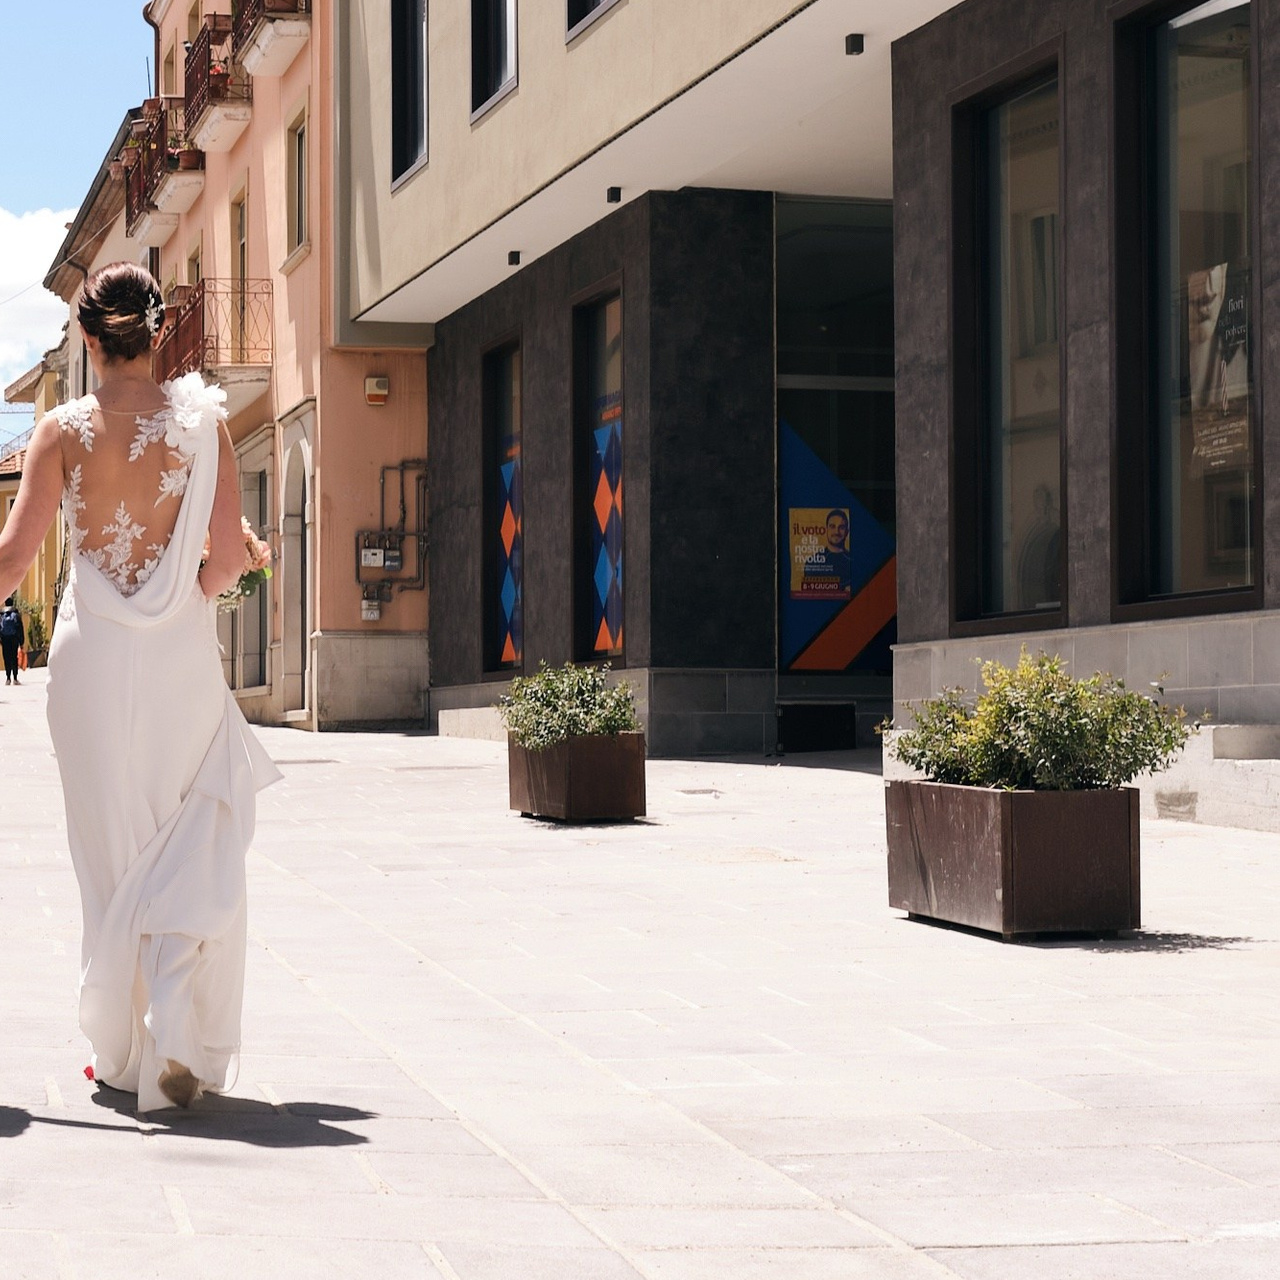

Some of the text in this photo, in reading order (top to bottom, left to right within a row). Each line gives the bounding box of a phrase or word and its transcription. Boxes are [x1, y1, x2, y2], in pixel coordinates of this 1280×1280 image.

[1228, 295, 1244, 313] fiori
[802, 526, 826, 535] voto
[809, 535, 818, 544] la
[794, 544, 825, 555] nostra
[794, 552, 826, 563] rivolta
